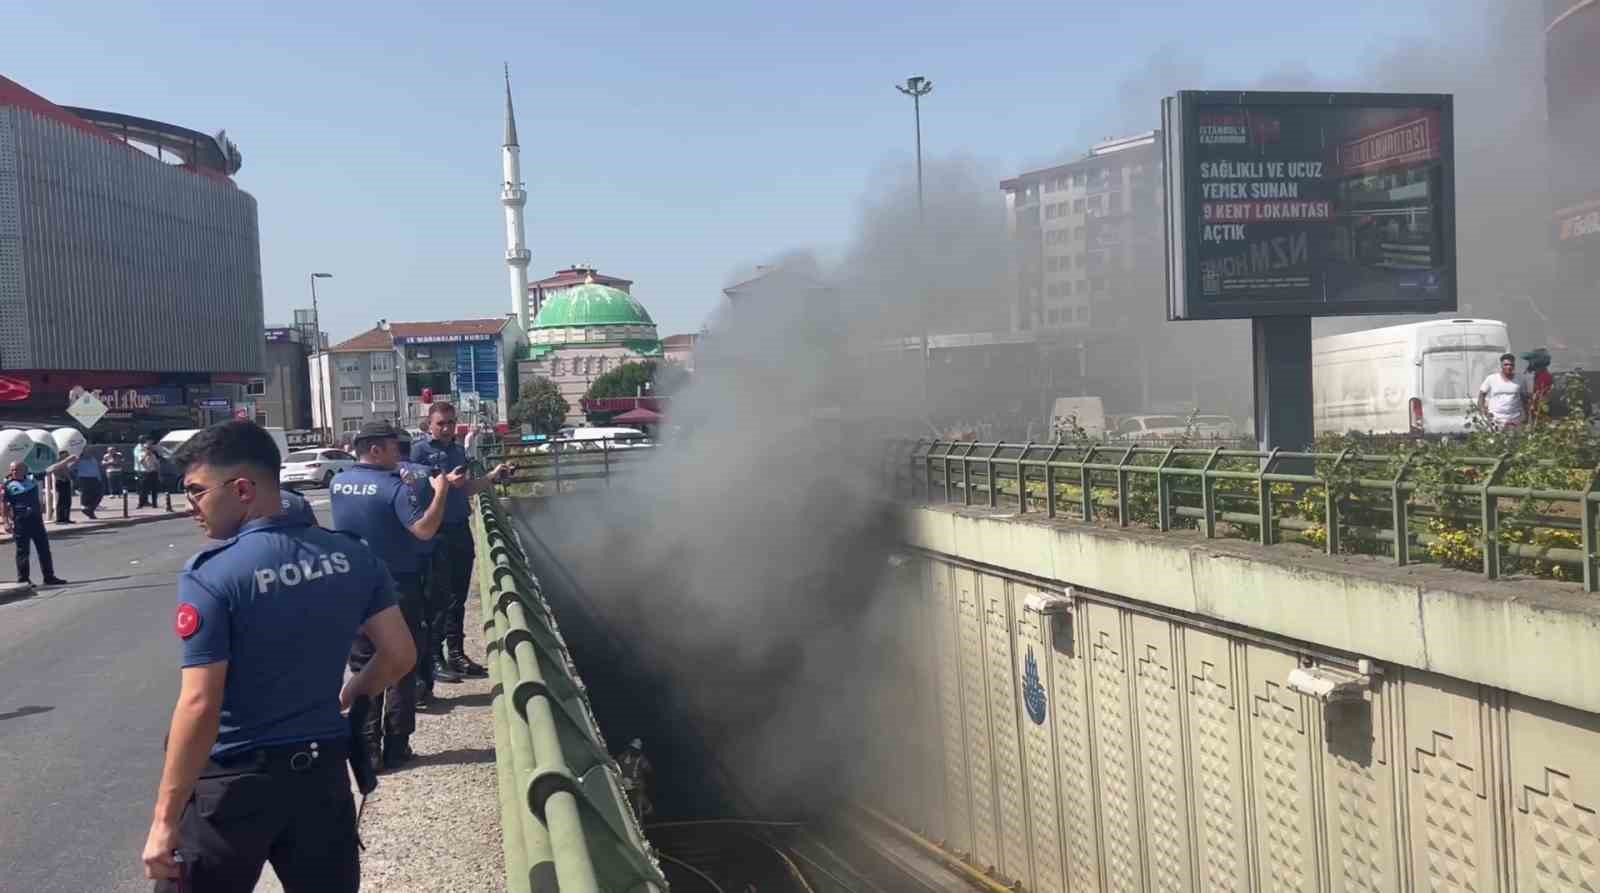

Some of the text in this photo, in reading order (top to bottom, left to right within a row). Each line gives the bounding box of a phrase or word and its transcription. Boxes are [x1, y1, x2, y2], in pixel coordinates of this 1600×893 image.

[1200, 160, 1322, 178] SAĞLIKLI VE UCUZ
[1202, 182, 1298, 199] YEMEK SUNAN
[1215, 203, 1250, 219] KENT
[1256, 202, 1329, 218] LOKANTASI
[1203, 224, 1246, 244] AÇTIK
